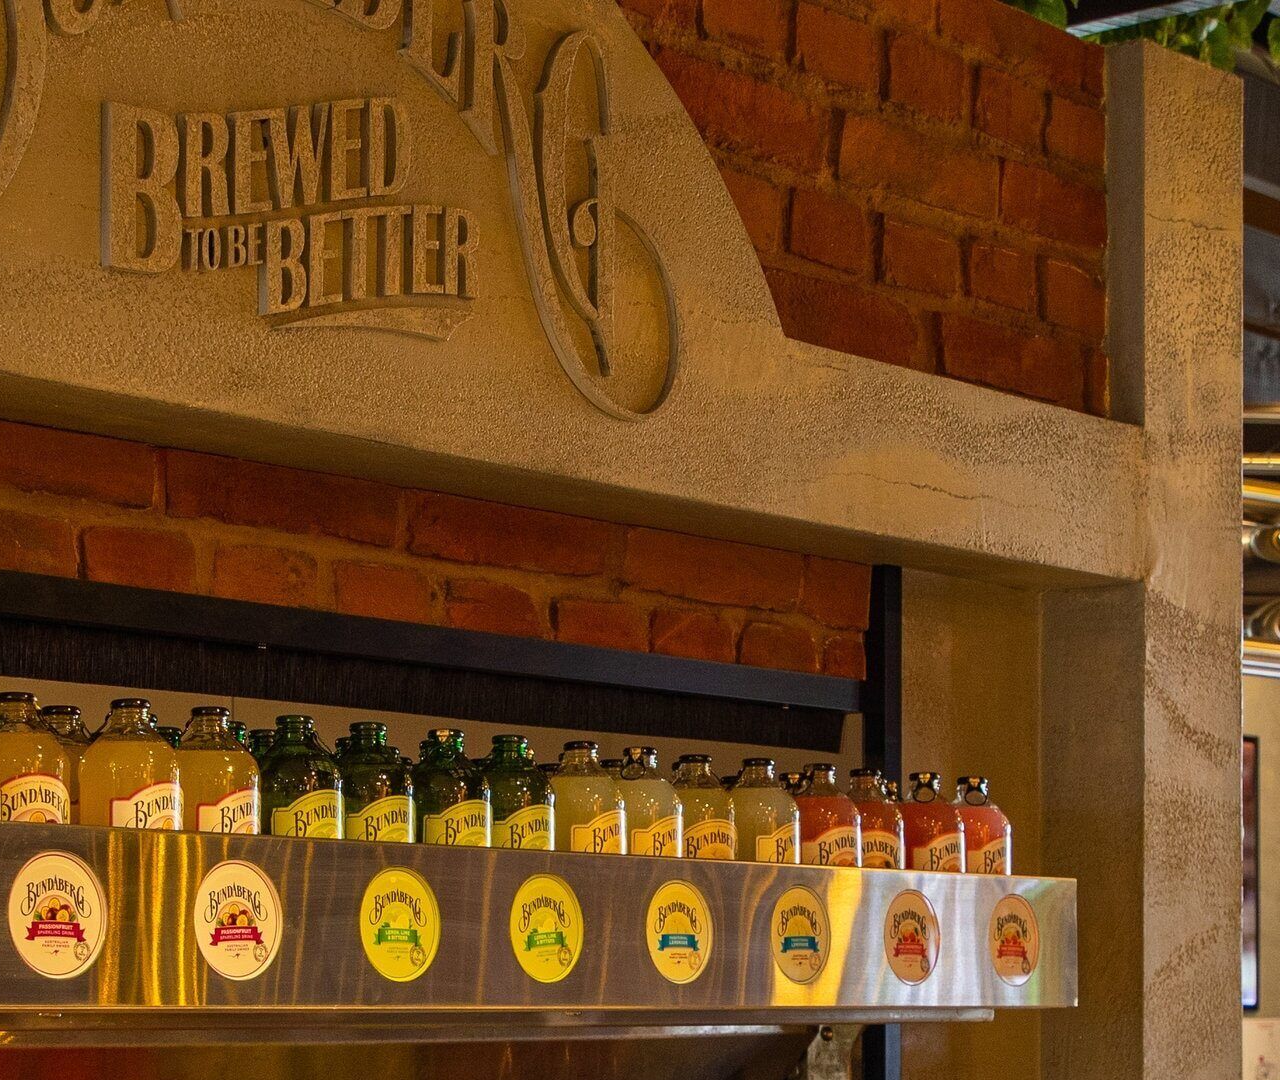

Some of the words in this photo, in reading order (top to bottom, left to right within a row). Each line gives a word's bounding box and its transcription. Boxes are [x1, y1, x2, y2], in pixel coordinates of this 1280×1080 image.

[101, 98, 416, 275] BREWED
[184, 227, 220, 271] TO
[227, 223, 263, 268] BE
[258, 204, 481, 316] BETTER
[287, 801, 341, 837] BUNDAB
[356, 806, 409, 841] BUNDAB
[435, 809, 490, 845] BUNDAB
[501, 814, 552, 848] BUNDAB
[685, 829, 736, 858] BUNDABER
[814, 830, 857, 865] BUNDAB
[862, 838, 901, 867] NDABERG
[21, 874, 91, 918] BUNDABERG
[204, 882, 268, 923] BUNDABERG
[369, 889, 427, 927] BUNDABERG
[519, 894, 571, 933] BUNDABERG
[654, 900, 703, 934] BUNDABERG
[777, 903, 822, 937] BUNDABERG
